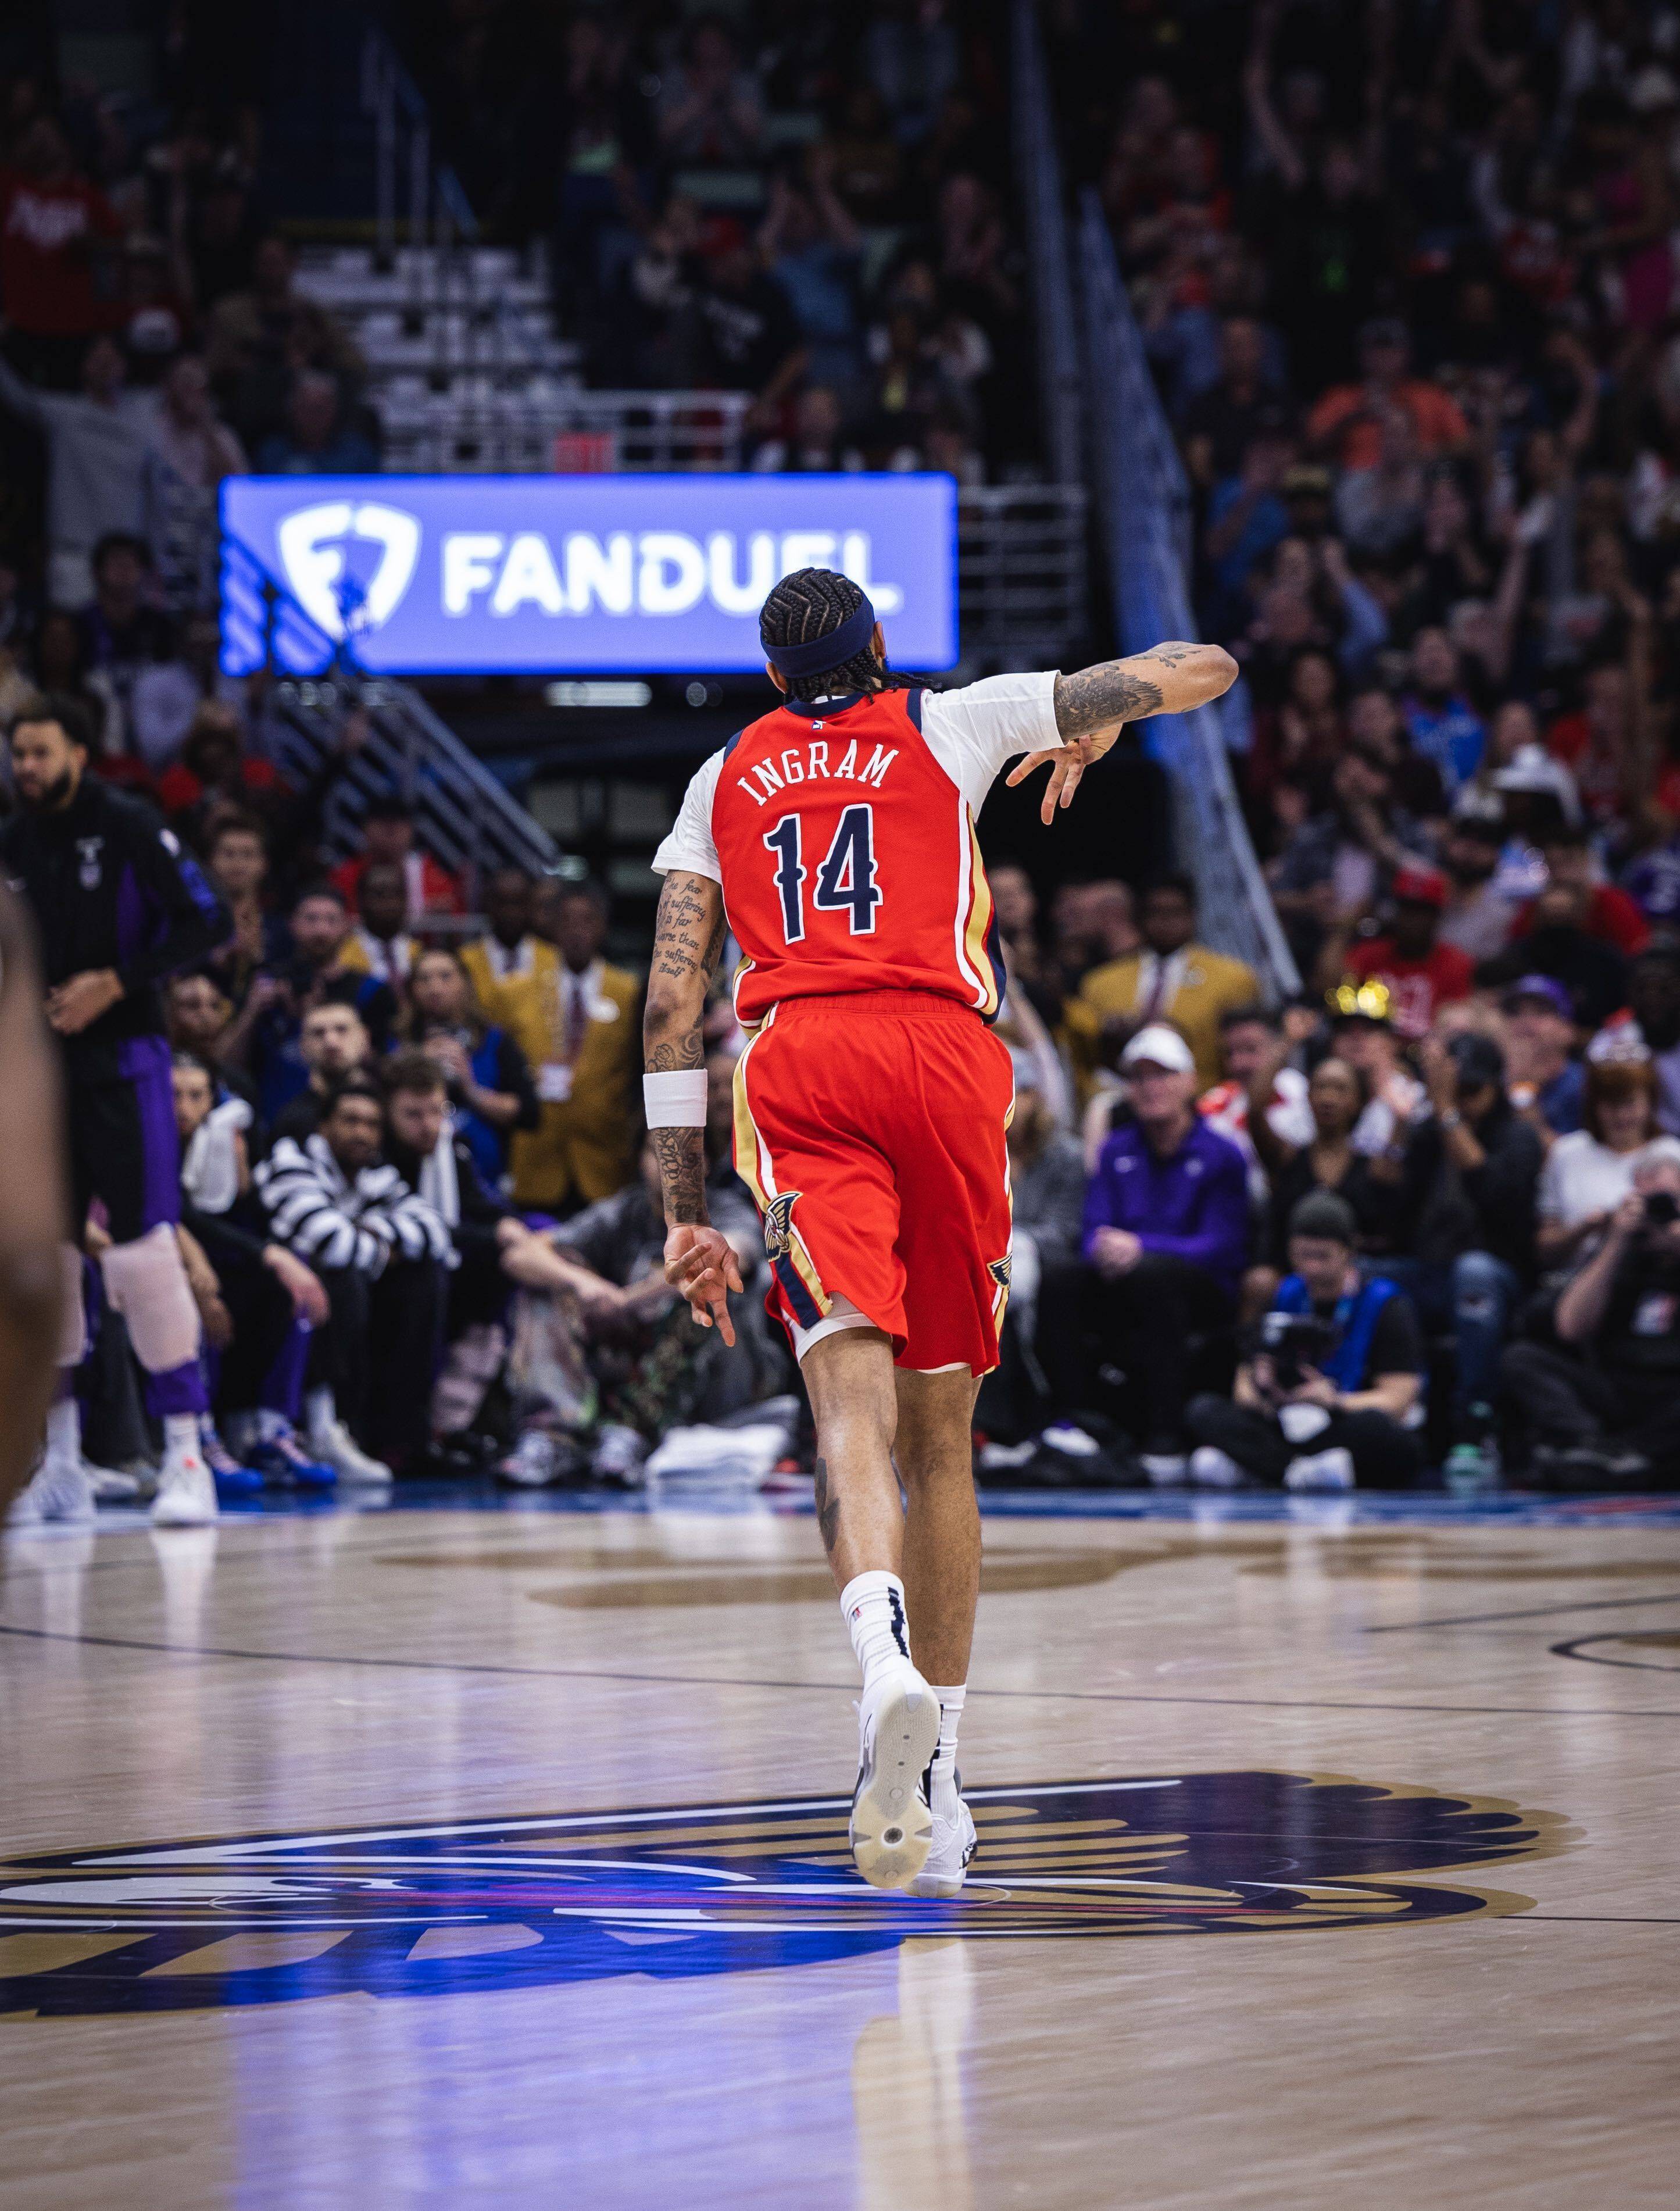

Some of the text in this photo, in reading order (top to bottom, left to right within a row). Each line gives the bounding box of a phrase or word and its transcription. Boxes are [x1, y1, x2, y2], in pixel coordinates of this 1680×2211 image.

[737, 739, 899, 806] INGRAM
[763, 803, 883, 945] 14
[679, 879, 702, 895] fear
[671, 896, 706, 922] suffering
[671, 912, 692, 929] far
[679, 932, 699, 950] than
[658, 963, 685, 978] itself
[664, 948, 698, 975] suffering
